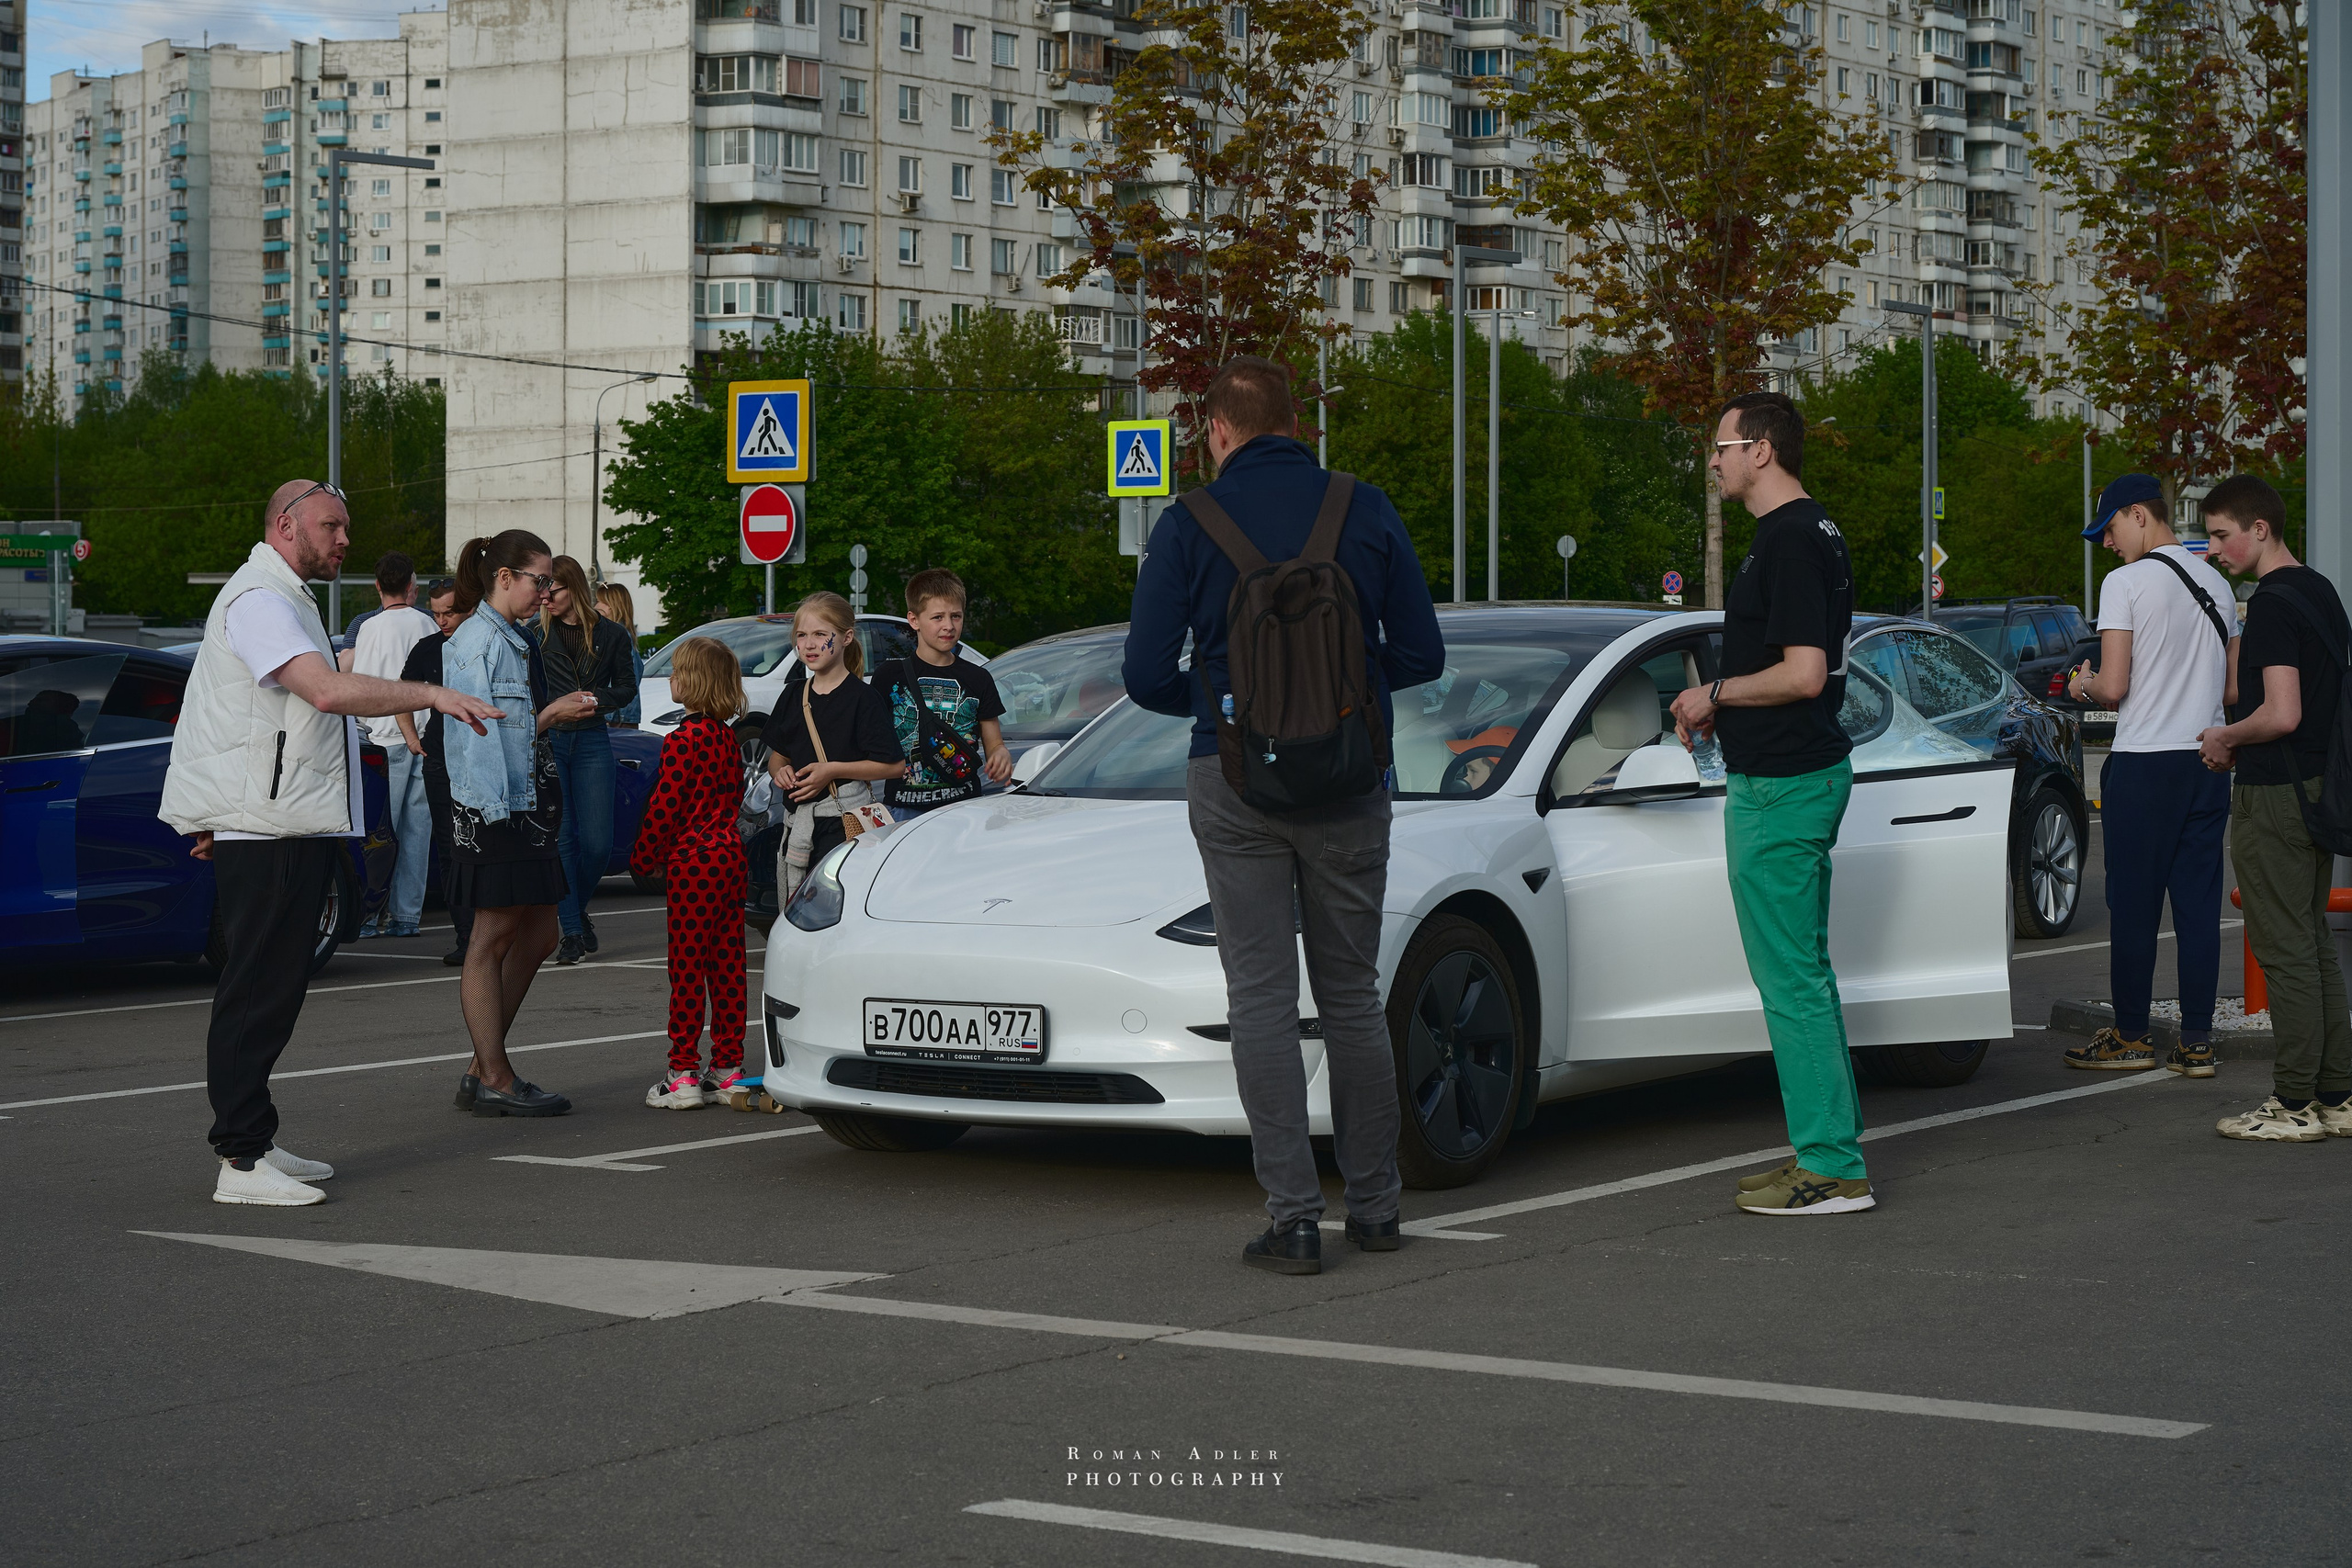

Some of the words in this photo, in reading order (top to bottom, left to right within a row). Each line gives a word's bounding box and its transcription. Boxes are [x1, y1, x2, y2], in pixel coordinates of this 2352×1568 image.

[895, 780, 974, 803] MINECRAFT
[988, 1010, 1032, 1037] 977
[999, 1037, 1021, 1048] RUS
